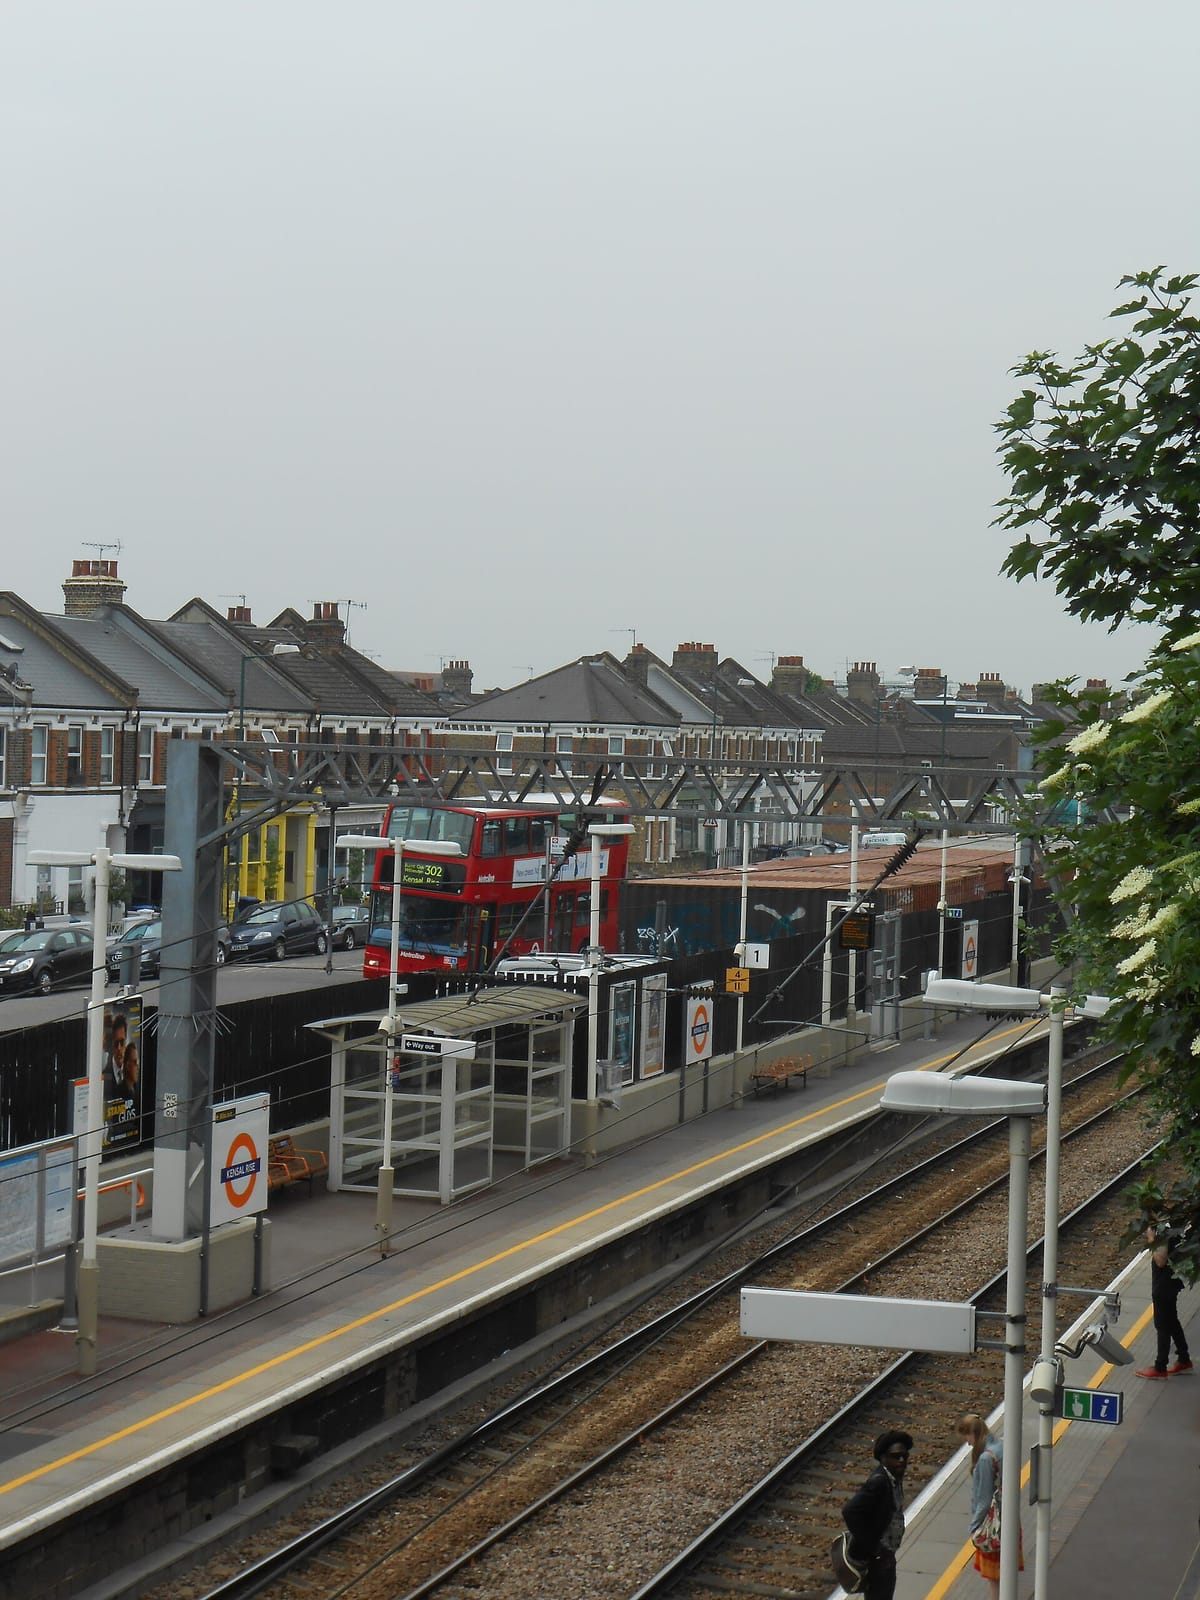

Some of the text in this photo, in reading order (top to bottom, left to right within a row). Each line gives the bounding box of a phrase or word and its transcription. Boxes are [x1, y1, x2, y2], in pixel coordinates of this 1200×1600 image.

[424, 864, 442, 877] 302
[403, 875, 424, 884] Kensal
[753, 950, 760, 962] 1
[412, 1041, 424, 1050] Way
[125, 1099, 134, 1110] UP
[226, 1161, 256, 1179] KENSAL RISE
